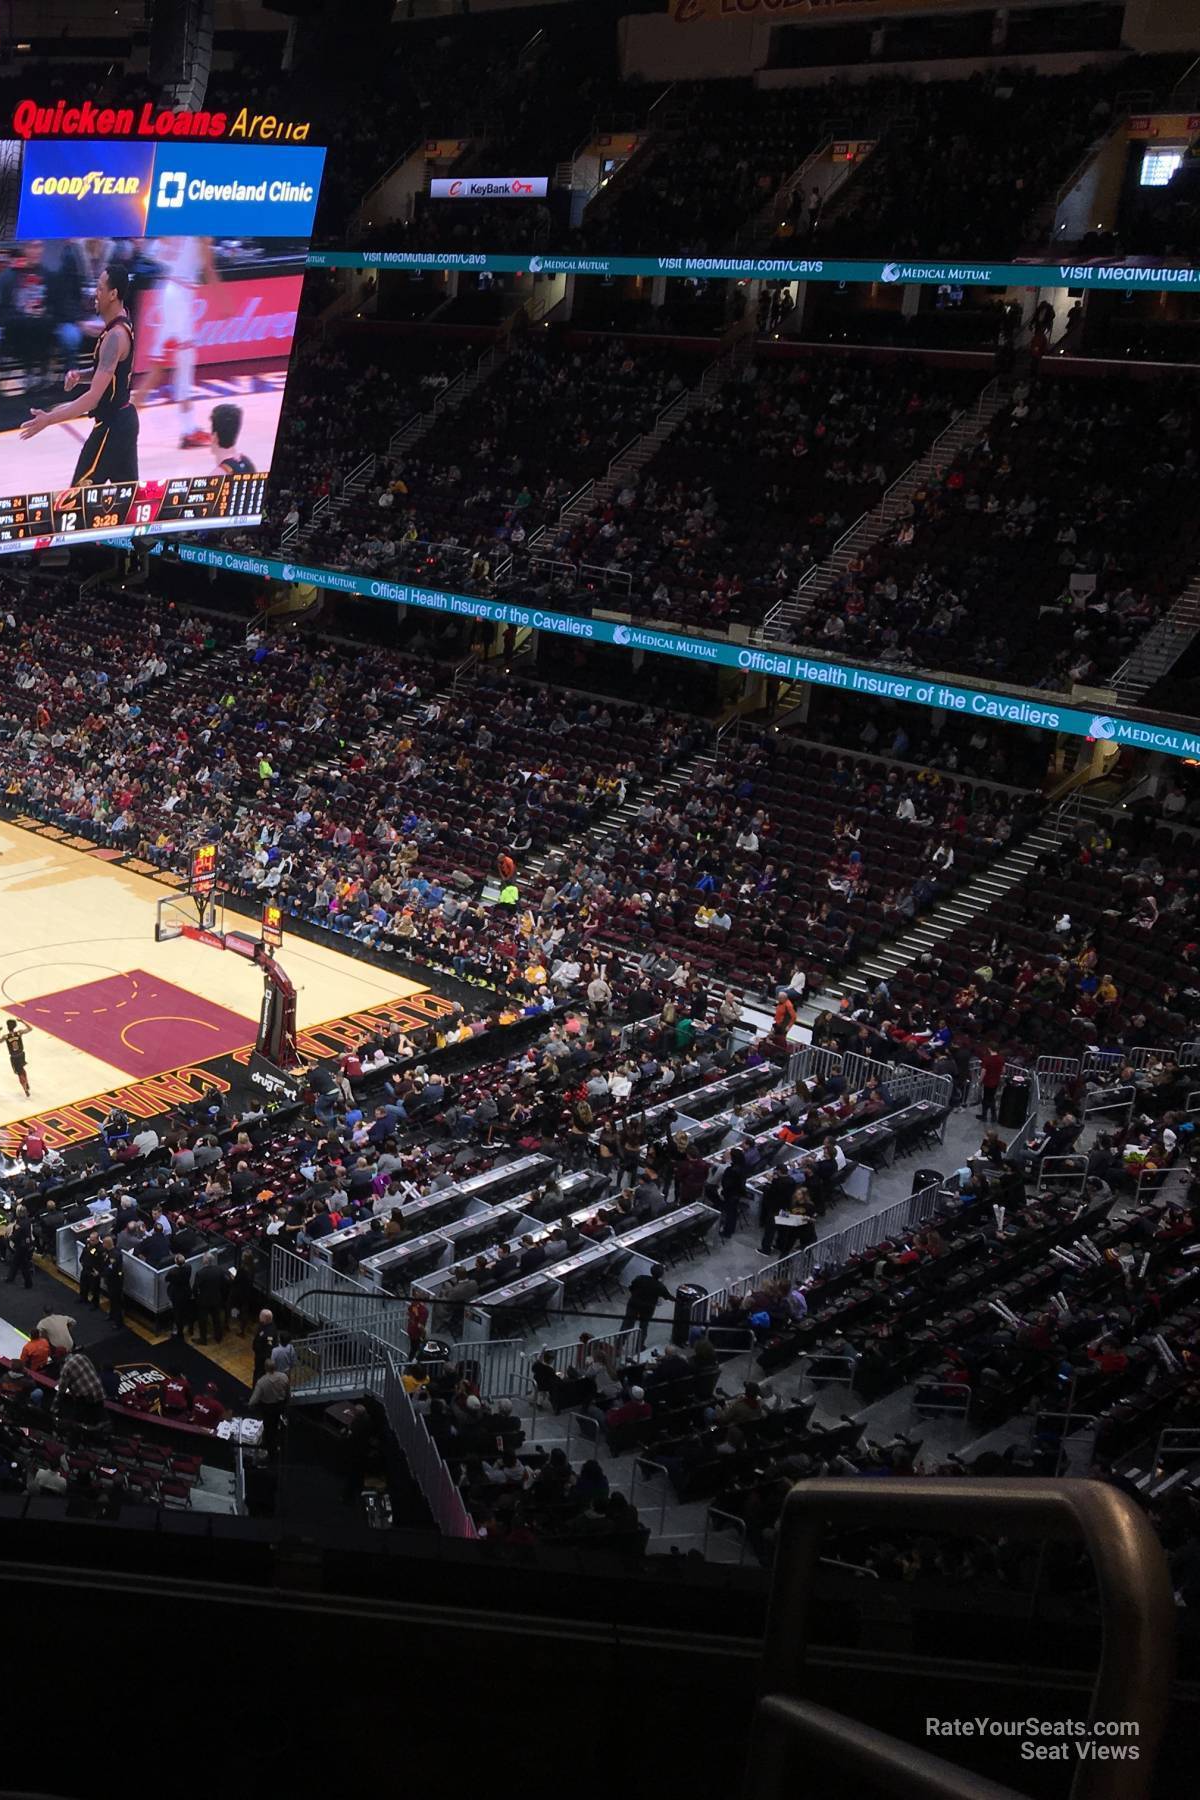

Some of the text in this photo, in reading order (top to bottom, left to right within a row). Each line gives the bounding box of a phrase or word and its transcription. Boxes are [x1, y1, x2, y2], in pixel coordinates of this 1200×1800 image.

[13, 99, 133, 139] Quicken
[138, 102, 227, 136] Loans
[31, 171, 140, 200] GOODYEAR
[188, 181, 314, 202] Cleveland Clinic
[470, 183, 510, 196] KeyBank
[544, 260, 609, 271] MEDICAL MUTUAL
[901, 268, 990, 281] MEDICAL MUTUAL
[120, 488, 133, 499] 24
[35, 510, 42, 521] 2
[61, 513, 77, 532] 12
[92, 515, 118, 528] 3:28
[136, 505, 151, 523] 19
[198, 551, 207, 563] of
[208, 552, 223, 566] the
[225, 554, 269, 575] Cavaliers
[296, 569, 356, 589] MEDICAL MUTUAL
[370, 581, 593, 637] Official Health Insurer of the Cavaliers
[631, 632, 716, 658] MEDICAL MUTUAL
[738, 650, 1060, 728] Official Health Insurer of the Cavaliers
[1118, 725, 1179, 750] MEDICAL
[251, 1071, 273, 1092] drug
